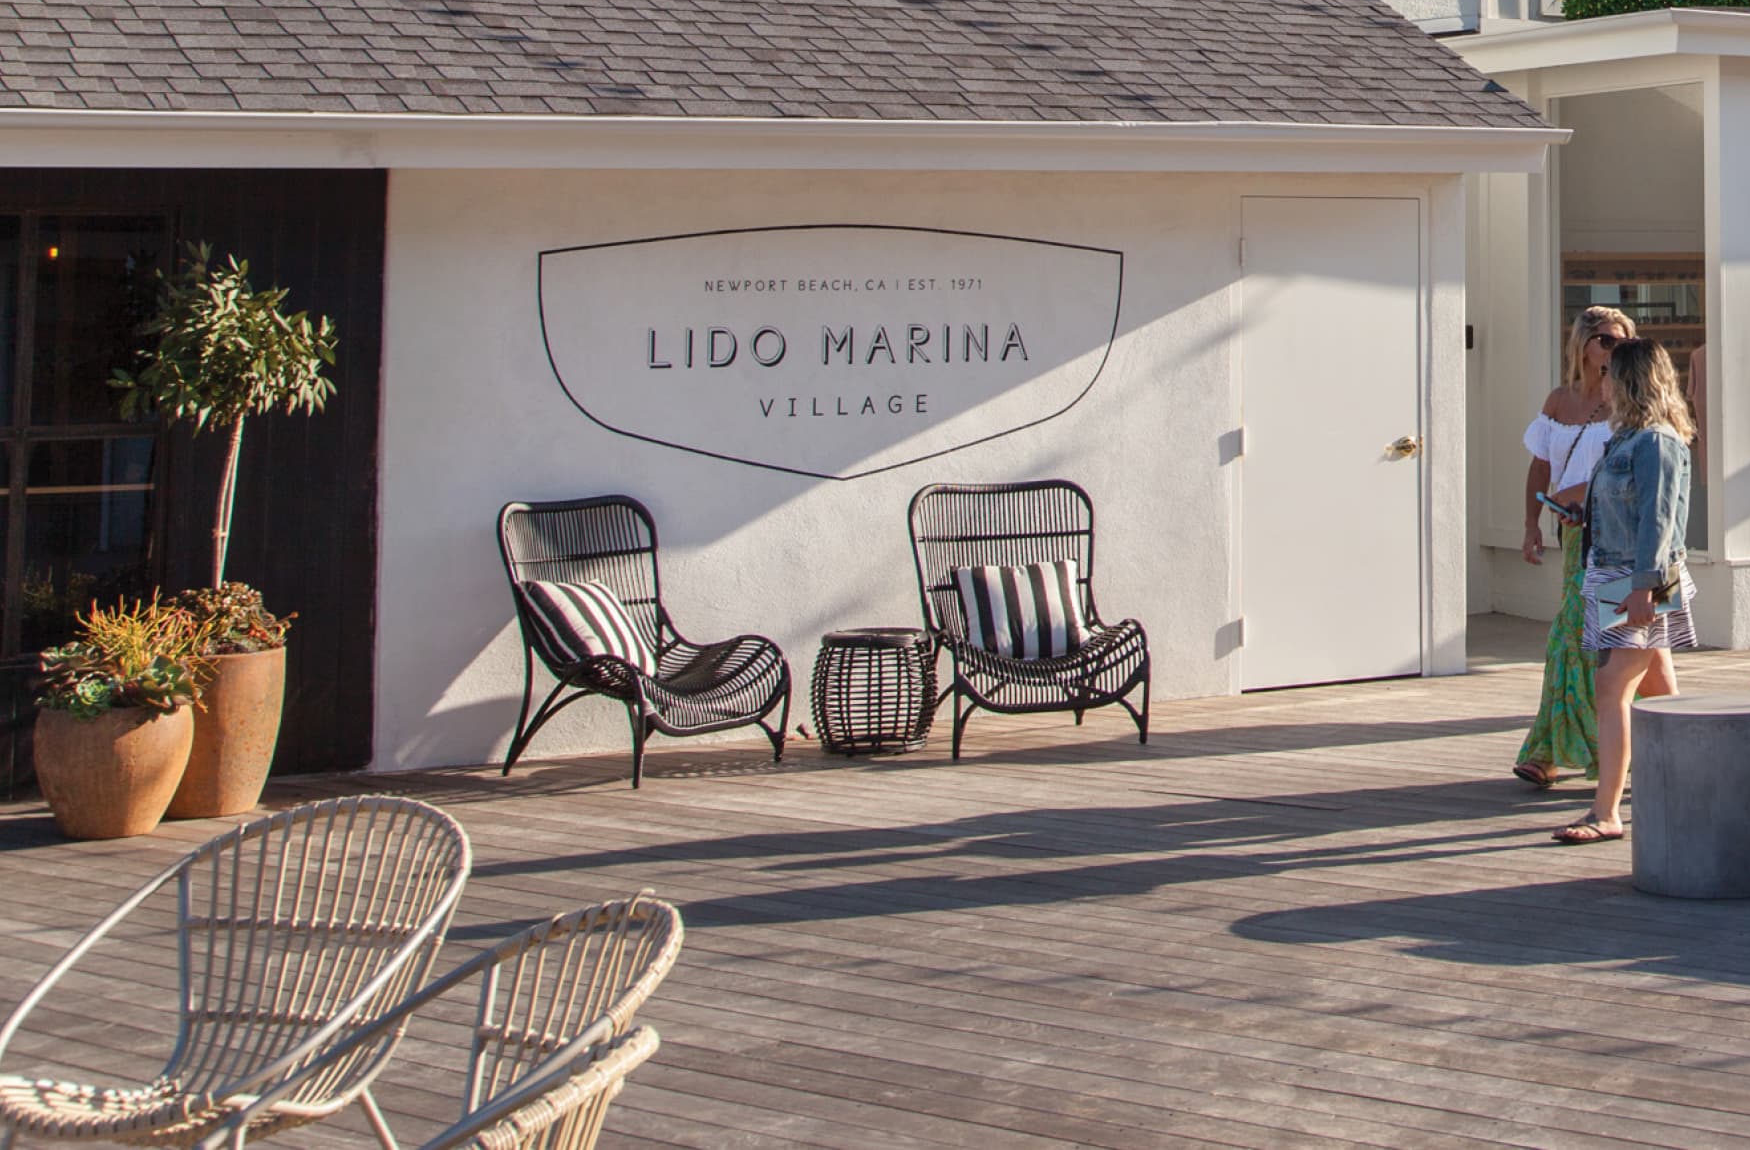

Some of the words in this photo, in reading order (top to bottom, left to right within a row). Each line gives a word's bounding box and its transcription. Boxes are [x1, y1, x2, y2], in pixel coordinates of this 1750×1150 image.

[704, 278, 788, 293] NEWPORT
[797, 278, 859, 293] BEACH,
[864, 278, 887, 291] CA
[949, 277, 982, 291] 1971
[647, 324, 787, 370] LIDO
[821, 321, 1030, 366] MARINA
[759, 393, 929, 419] VILLAGE
